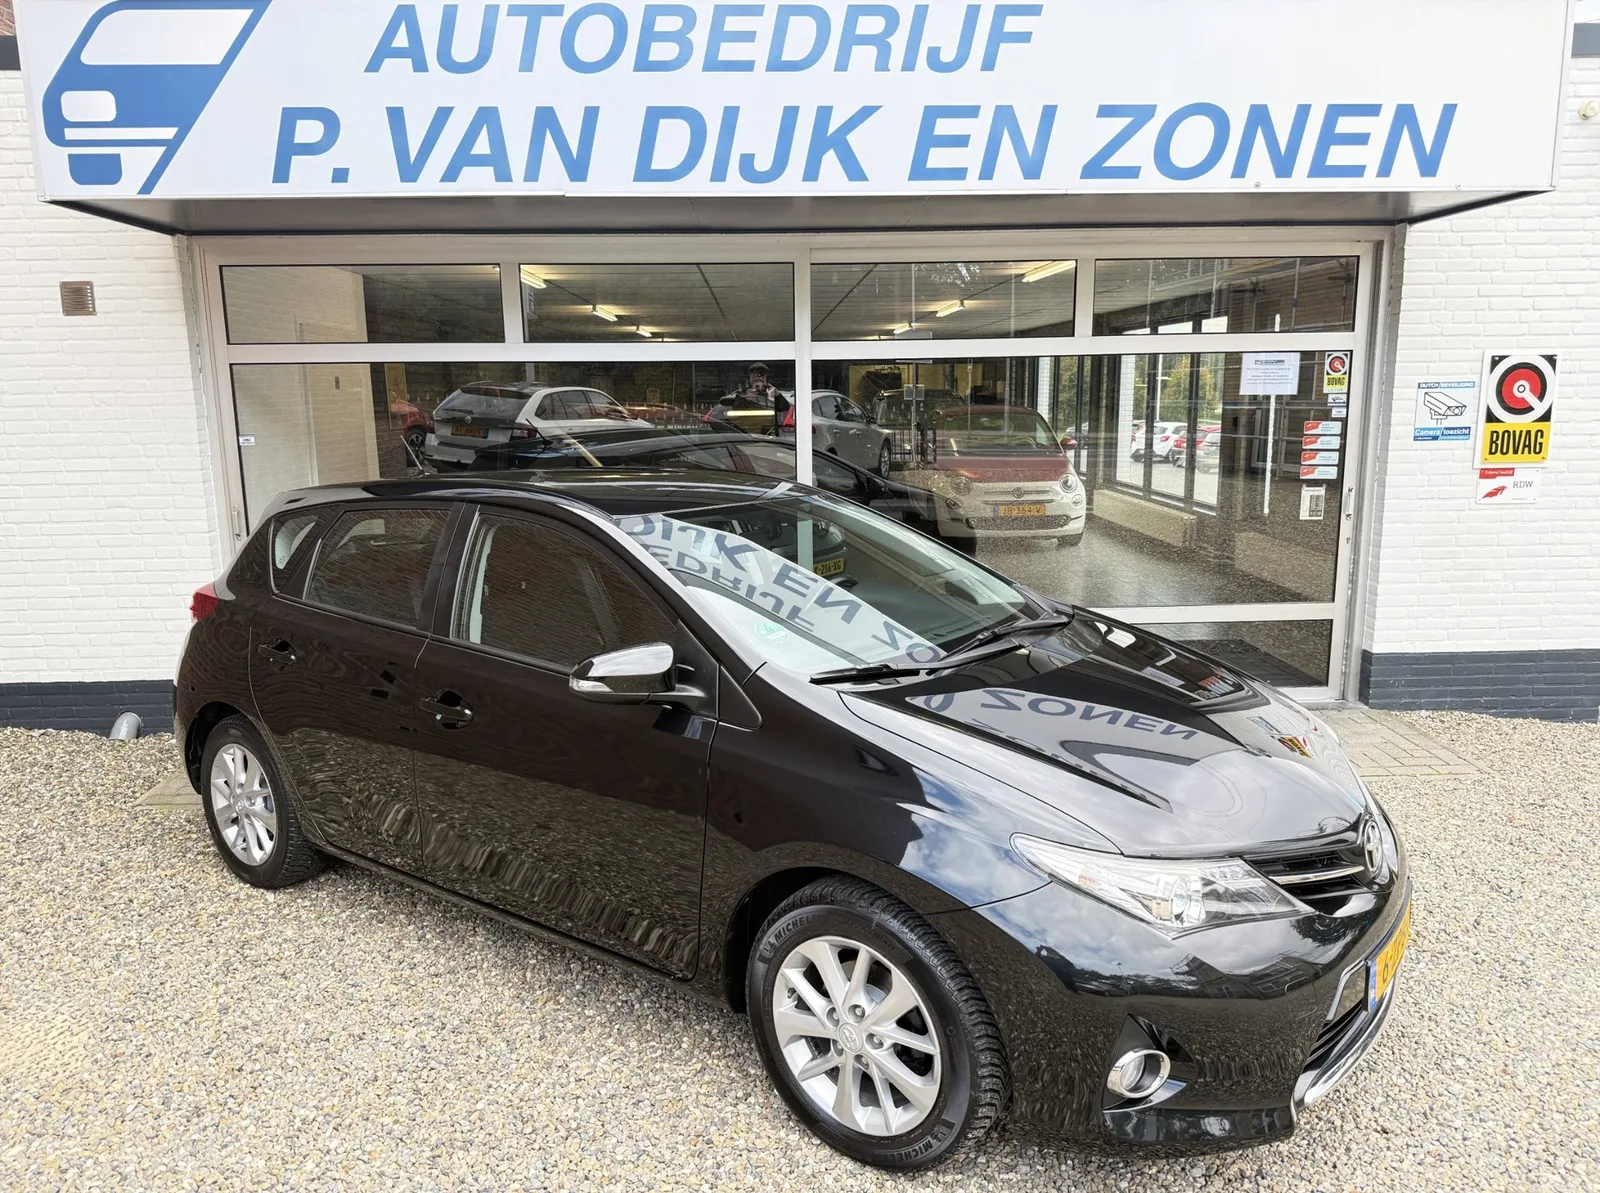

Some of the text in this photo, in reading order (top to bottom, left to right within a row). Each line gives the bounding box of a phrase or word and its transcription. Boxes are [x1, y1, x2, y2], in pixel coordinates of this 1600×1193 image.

[366, 3, 1042, 74] AUTOBEDRIJF
[273, 103, 1456, 184] P. VAN DIJK EN ZONEN
[1327, 376, 1346, 386] BOVAG
[1488, 429, 1544, 456] BOVAG
[1512, 480, 1534, 489] RDW
